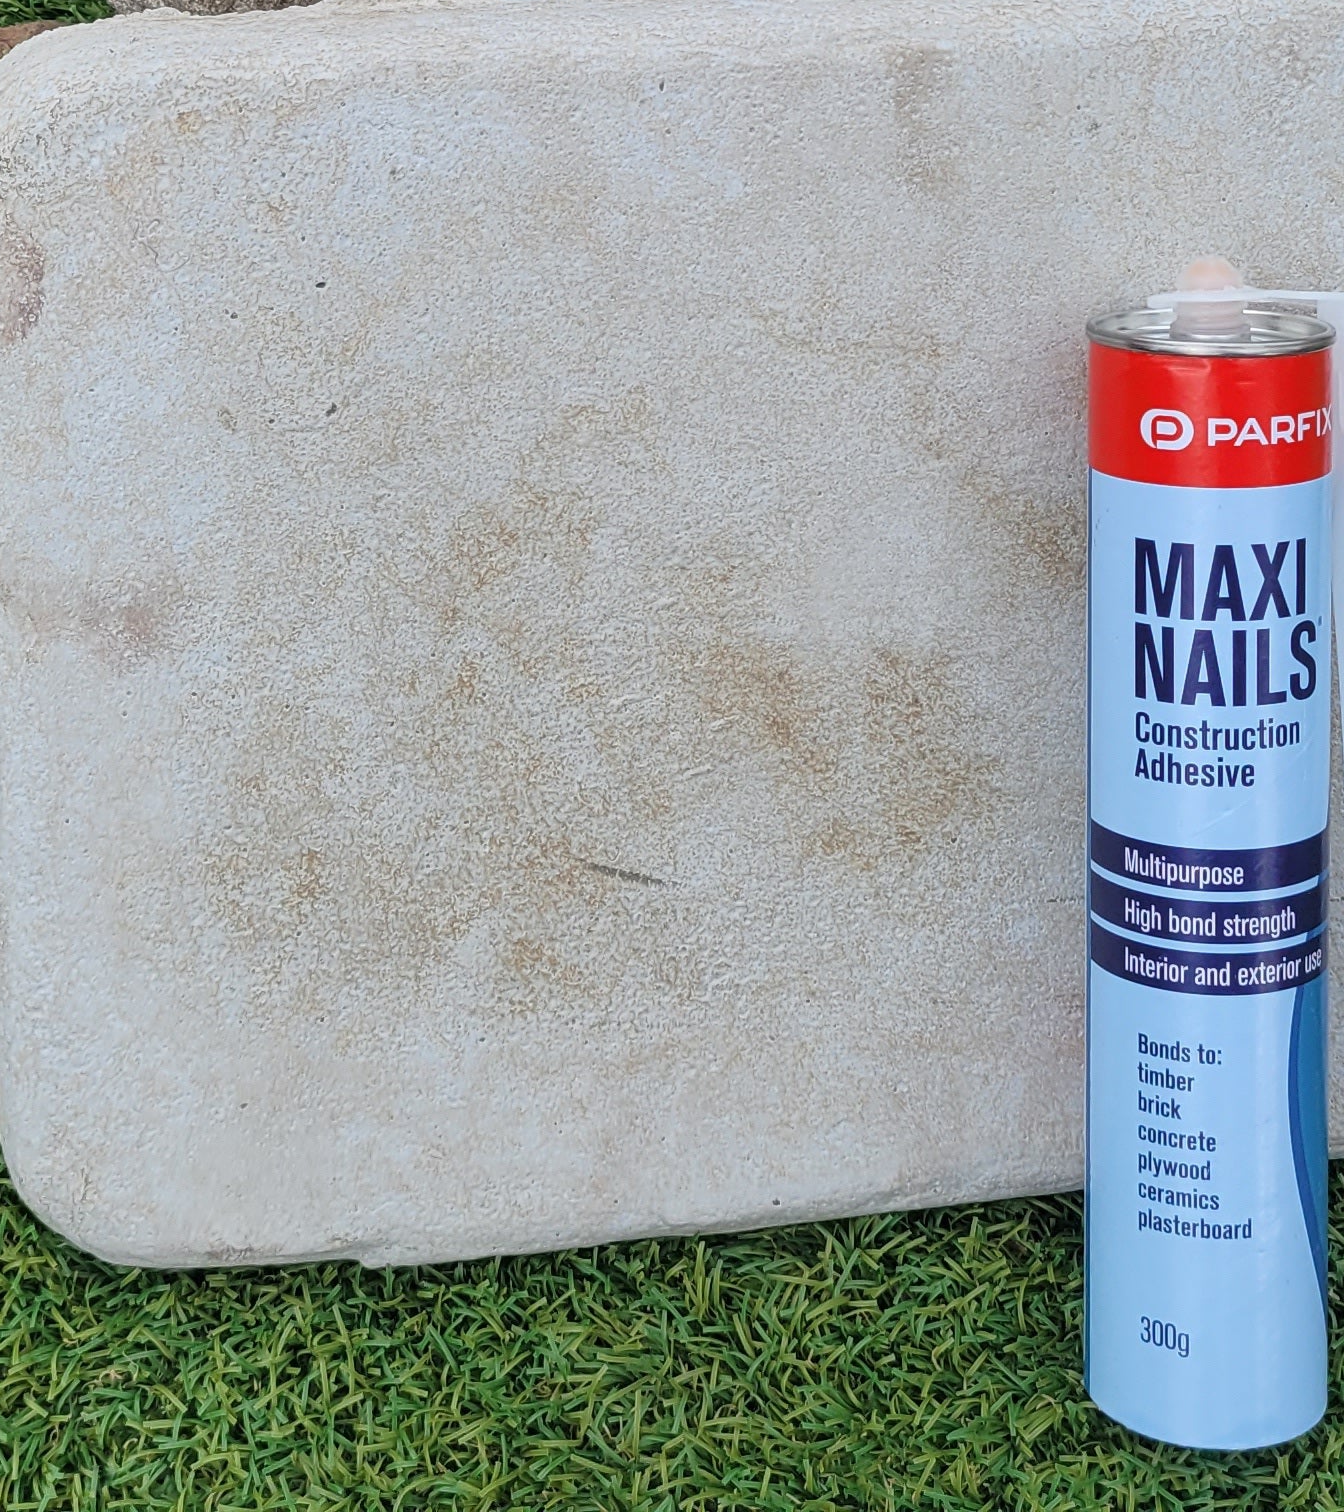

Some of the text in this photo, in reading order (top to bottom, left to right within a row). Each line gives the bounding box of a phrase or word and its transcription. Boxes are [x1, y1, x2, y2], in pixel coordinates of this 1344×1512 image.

[1207, 404, 1332, 447] PARFIX
[1134, 537, 1307, 621] MAXI
[1134, 620, 1318, 707] NAILS
[1134, 712, 1300, 750] Construction
[1134, 748, 1255, 787] Adhesive
[1124, 848, 1244, 888] Multipurpose
[1124, 898, 1296, 937] High bond strength
[1124, 946, 1322, 987] Interior and exterior use
[1138, 1033, 1222, 1066] Bonds to:
[1138, 1062, 1195, 1092] timber
[1138, 1091, 1181, 1120] brick
[1138, 1125, 1216, 1152] concrete
[1138, 1150, 1211, 1181] plywood
[1138, 1181, 1220, 1211] ceramics
[1138, 1208, 1253, 1240] plasterboard
[1139, 1316, 1191, 1358] 300g
